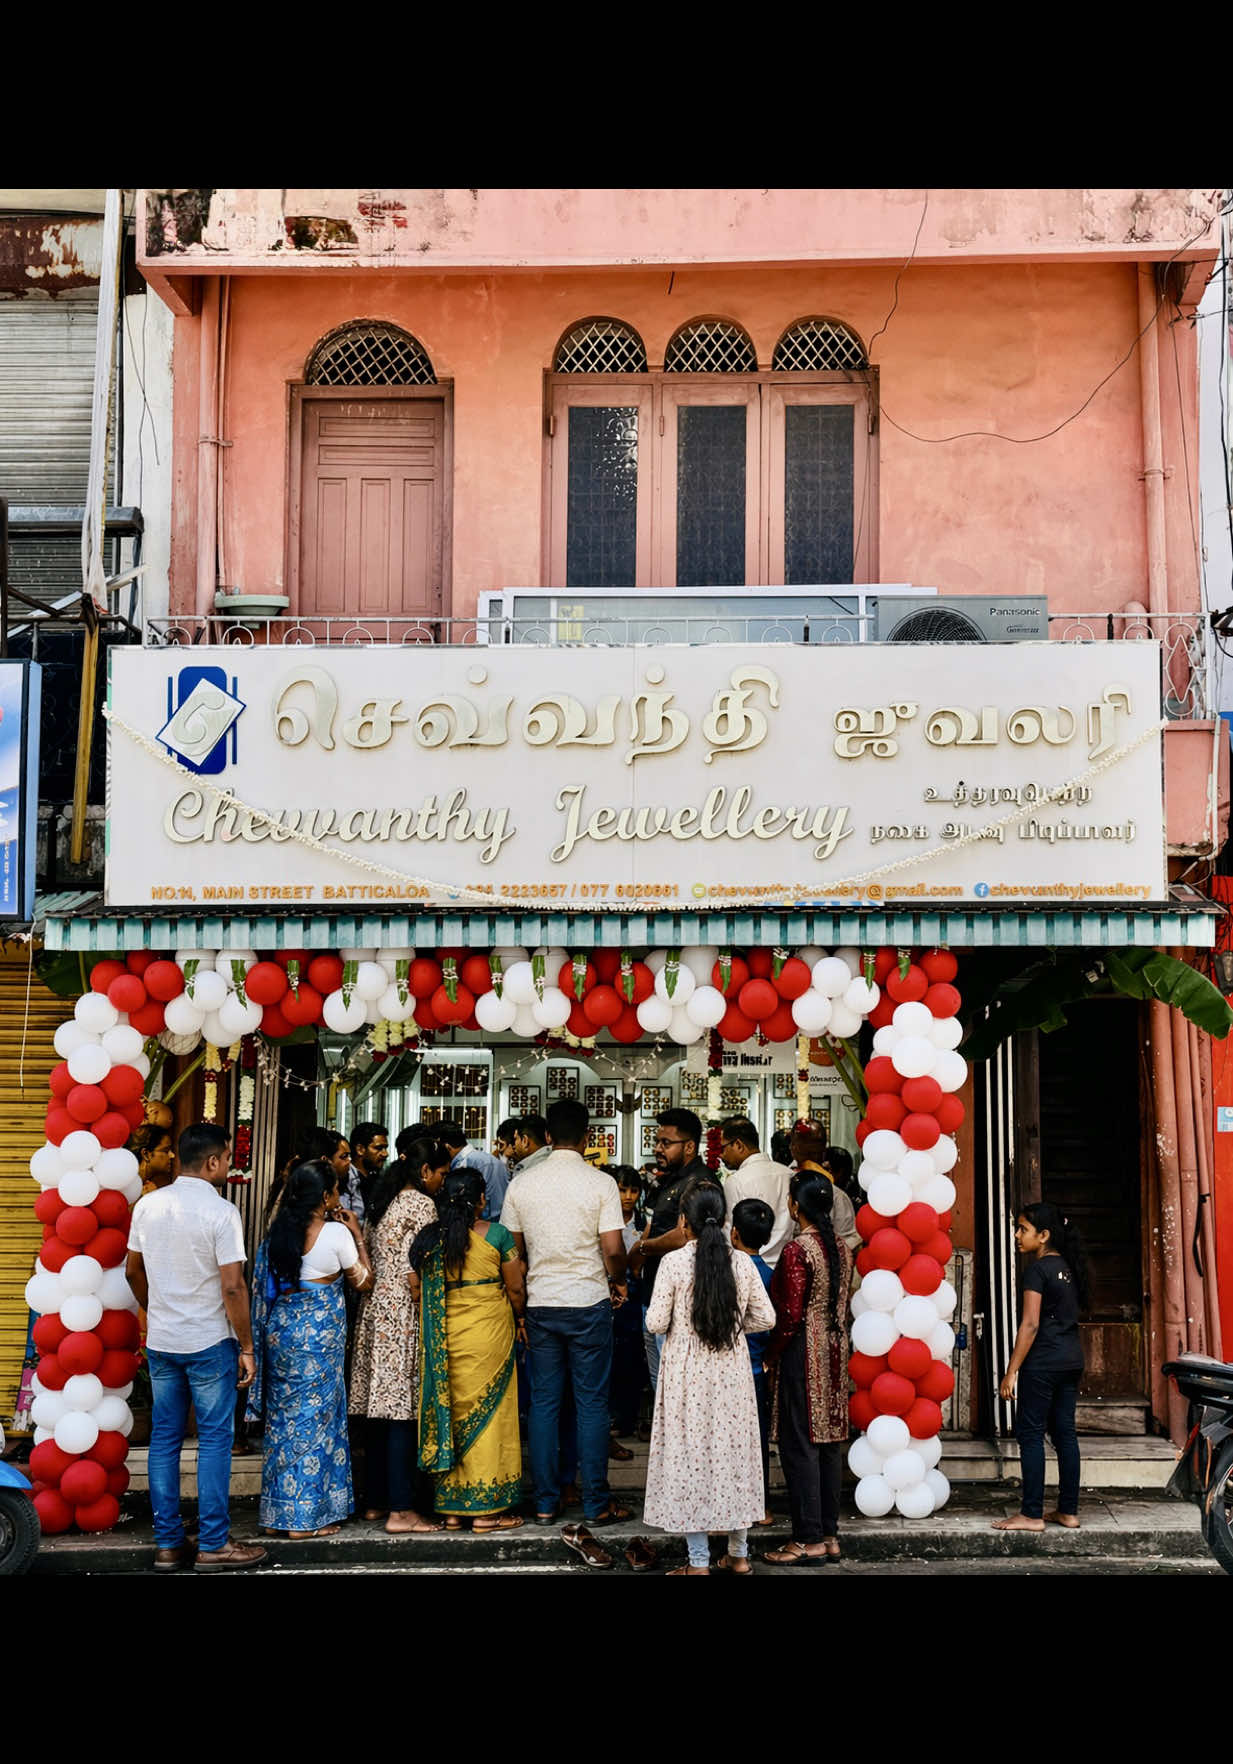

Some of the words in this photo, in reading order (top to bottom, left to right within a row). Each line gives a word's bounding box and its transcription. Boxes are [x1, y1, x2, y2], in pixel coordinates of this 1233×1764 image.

[989, 607, 1041, 616] Panasonic
[273, 664, 780, 766] செவ்வந்தி
[162, 785, 516, 865] Chevvanthy
[550, 784, 854, 864] Jewellery
[871, 823, 929, 844] நகை
[203, 885, 244, 899] MAIN
[249, 885, 314, 899] STREET
[323, 885, 431, 899] BATTICALOA
[580, 883, 610, 897] 077
